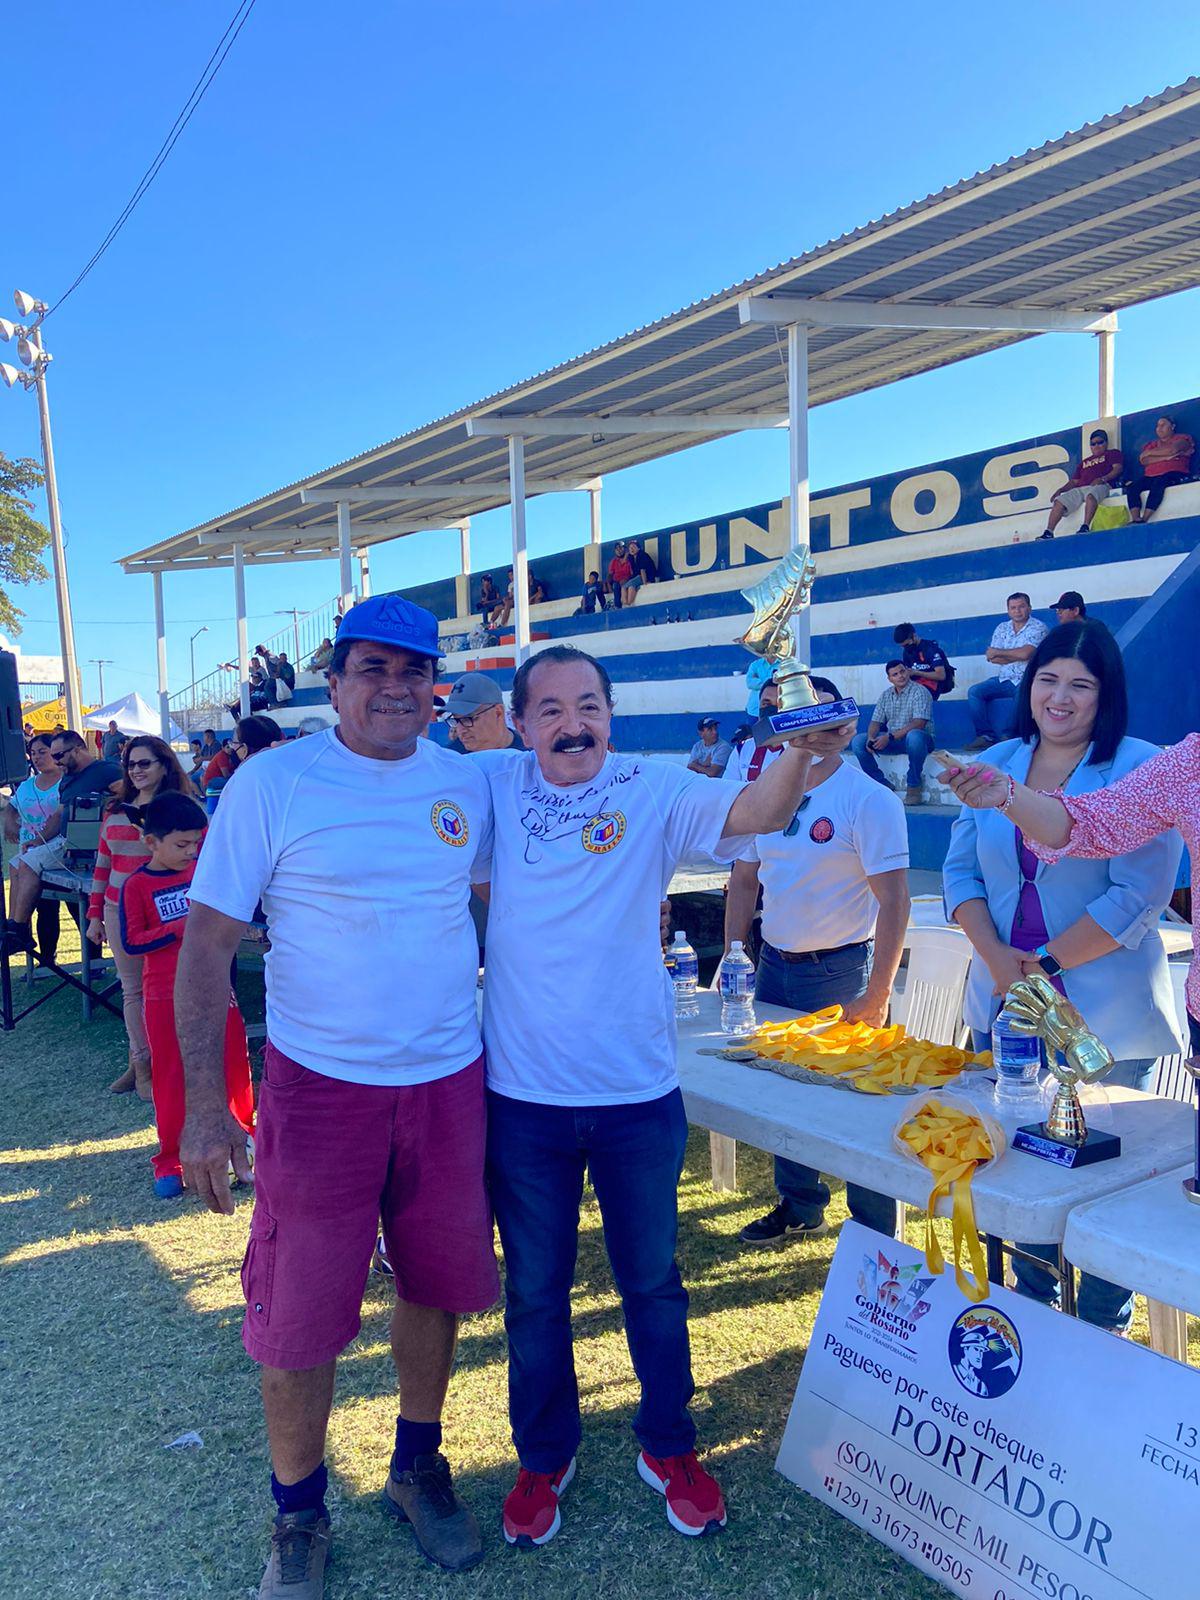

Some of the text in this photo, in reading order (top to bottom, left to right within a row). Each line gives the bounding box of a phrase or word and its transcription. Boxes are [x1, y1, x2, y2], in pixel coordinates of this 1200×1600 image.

[371, 620, 421, 636] adidas
[855, 1294, 917, 1333] Gobierno
[870, 1311, 910, 1341] Rosario
[823, 1332, 1068, 1484] Paguese por este cheque a:
[1176, 1422, 1198, 1448] 13
[1141, 1443, 1199, 1486] FECHA
[890, 1404, 1113, 1567] PORTADOR
[837, 1440, 1094, 1600] (SON QUINCE MIL PESO
